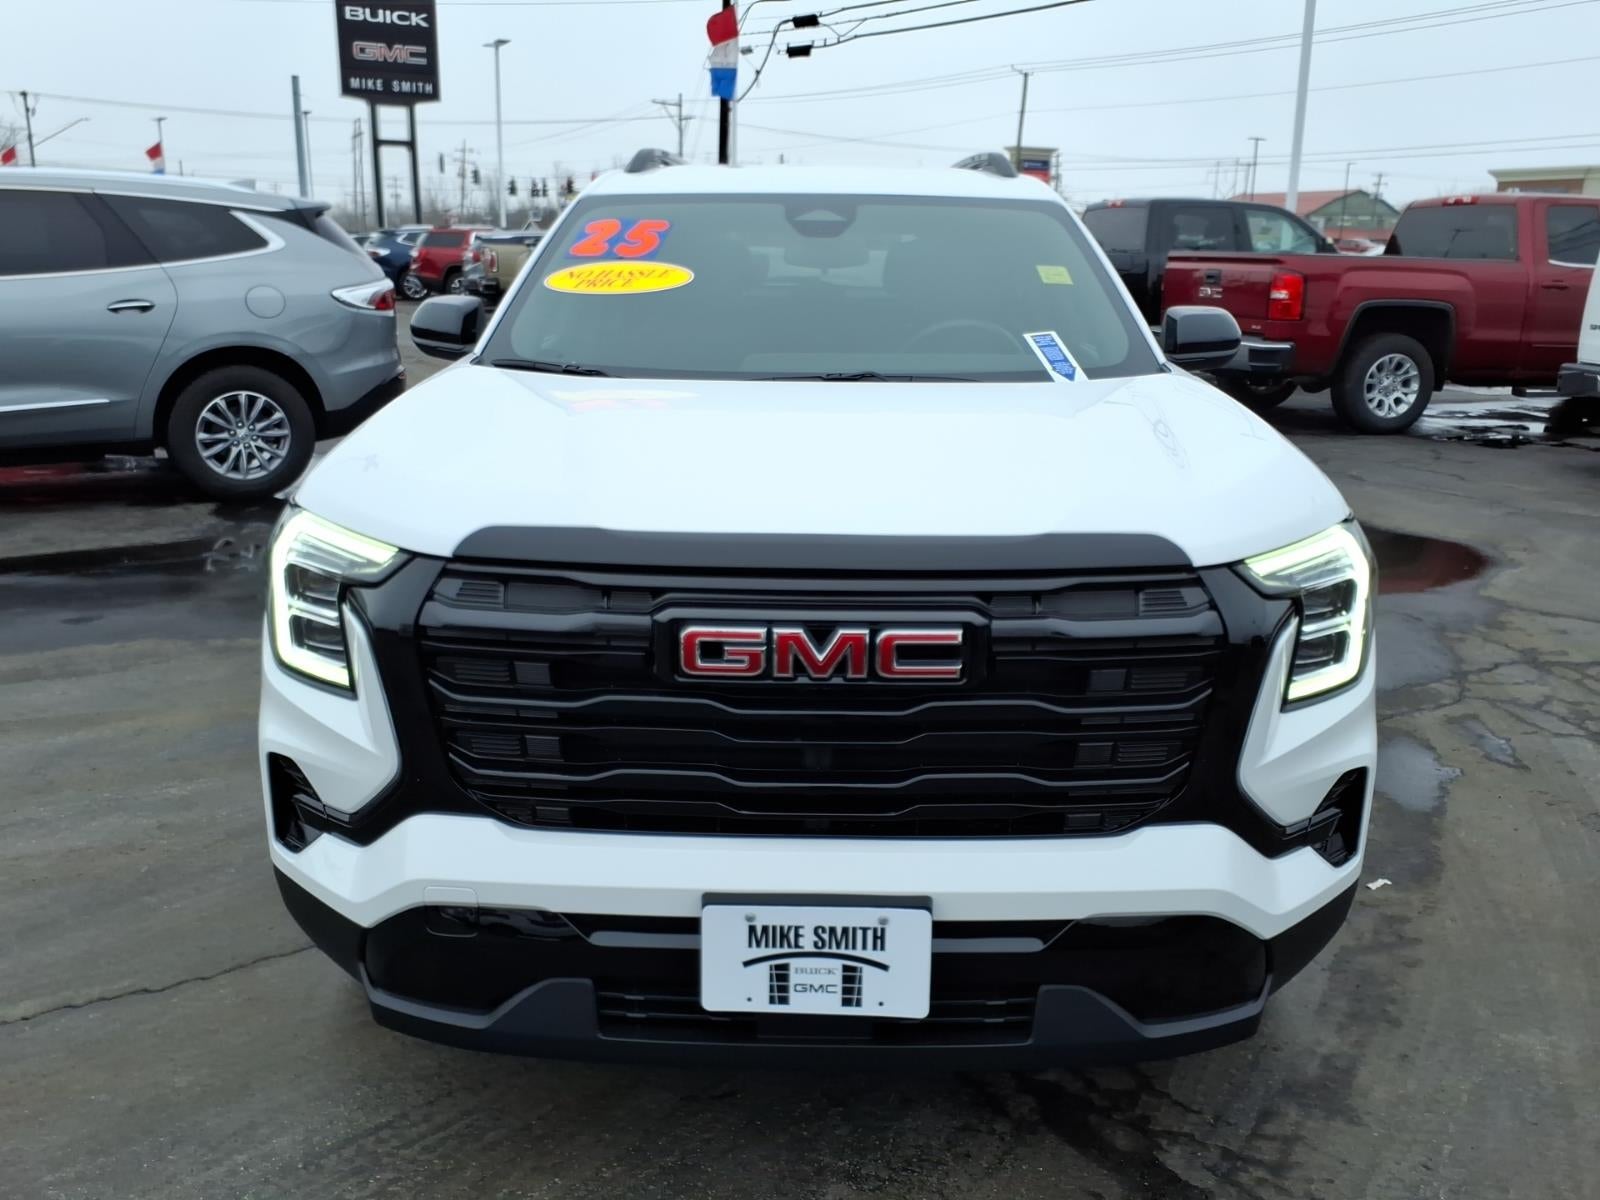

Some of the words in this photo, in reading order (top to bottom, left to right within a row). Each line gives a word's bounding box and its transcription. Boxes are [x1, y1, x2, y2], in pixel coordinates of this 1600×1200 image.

[344, 6, 430, 27] BUICK
[352, 41, 427, 65] GMC
[349, 77, 384, 91] MIKE
[392, 80, 433, 94] SMITH
[569, 218, 671, 257] 25
[573, 279, 634, 289] PRICE
[680, 626, 963, 678] GMC
[747, 924, 805, 949] MIKE
[813, 926, 886, 951] SMITH
[794, 967, 838, 975] BUICK
[793, 983, 838, 994] GMC
